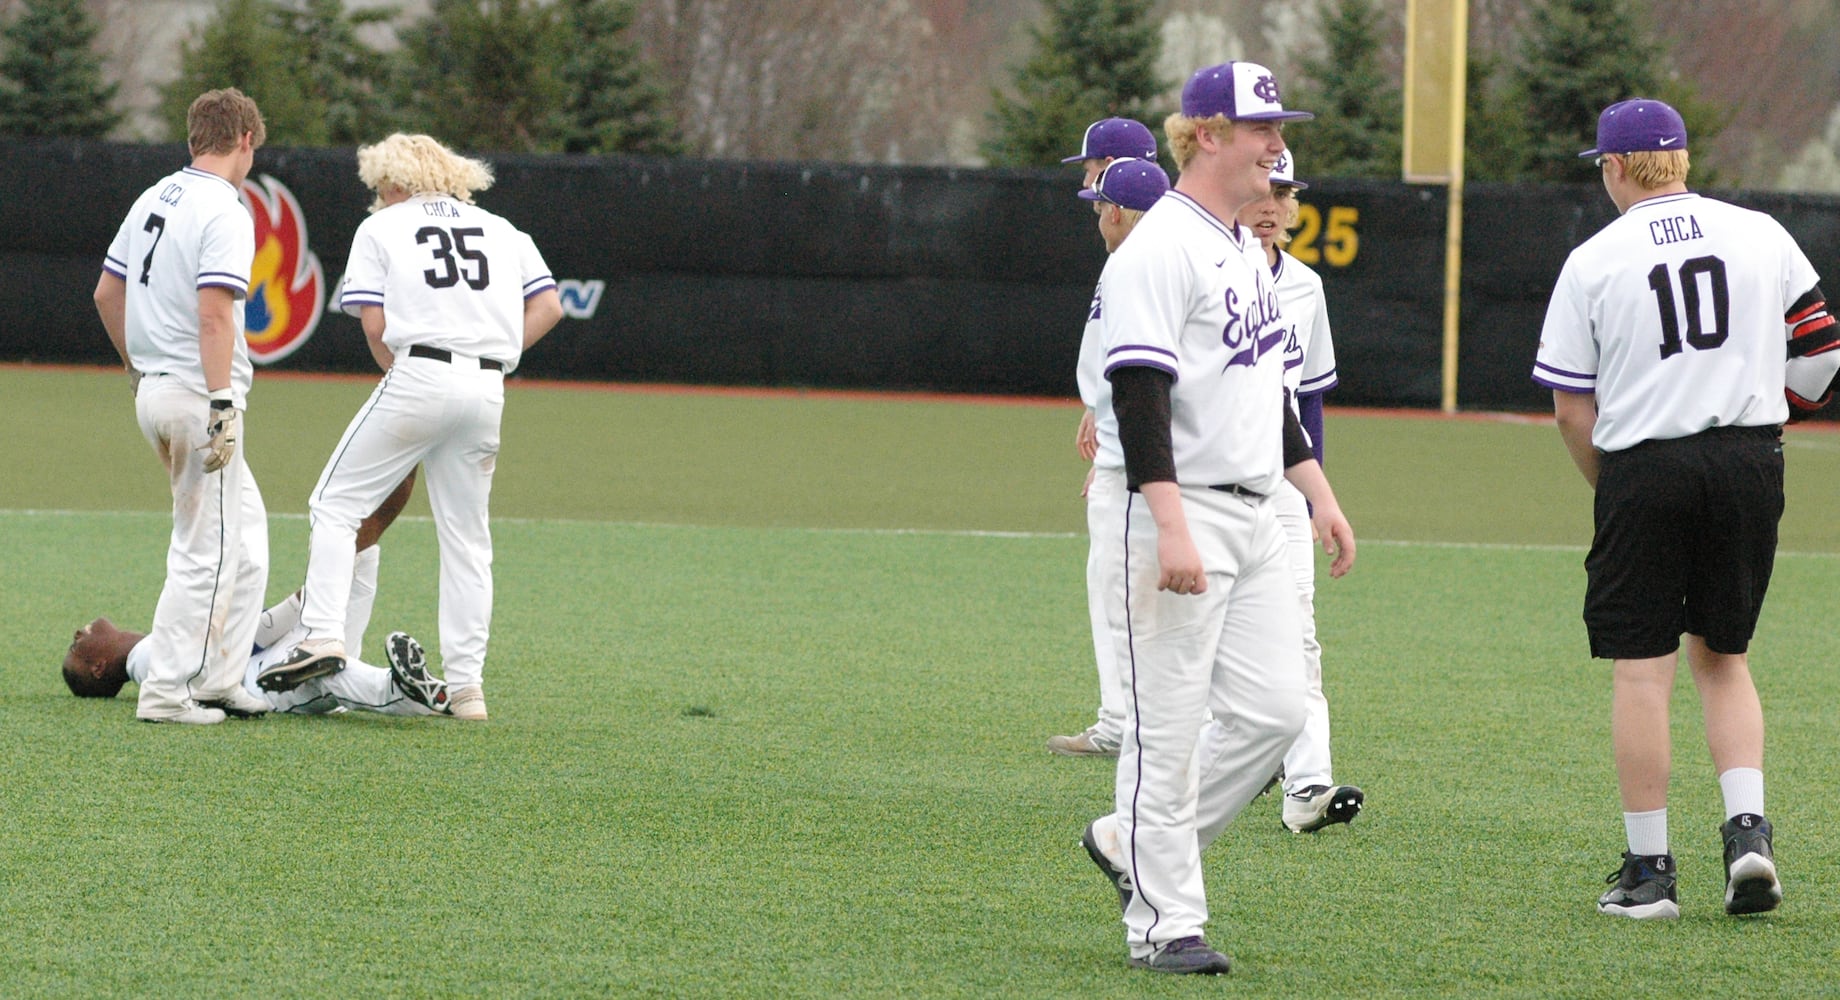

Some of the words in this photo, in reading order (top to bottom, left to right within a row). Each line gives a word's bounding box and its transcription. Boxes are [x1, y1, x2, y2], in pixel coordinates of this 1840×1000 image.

[422, 201, 461, 218] CHCA
[1280, 203, 1359, 267] 25
[1649, 214, 1704, 246] CHCA
[139, 212, 166, 287] 7
[415, 226, 490, 291] 35
[1647, 254, 1730, 360] 10
